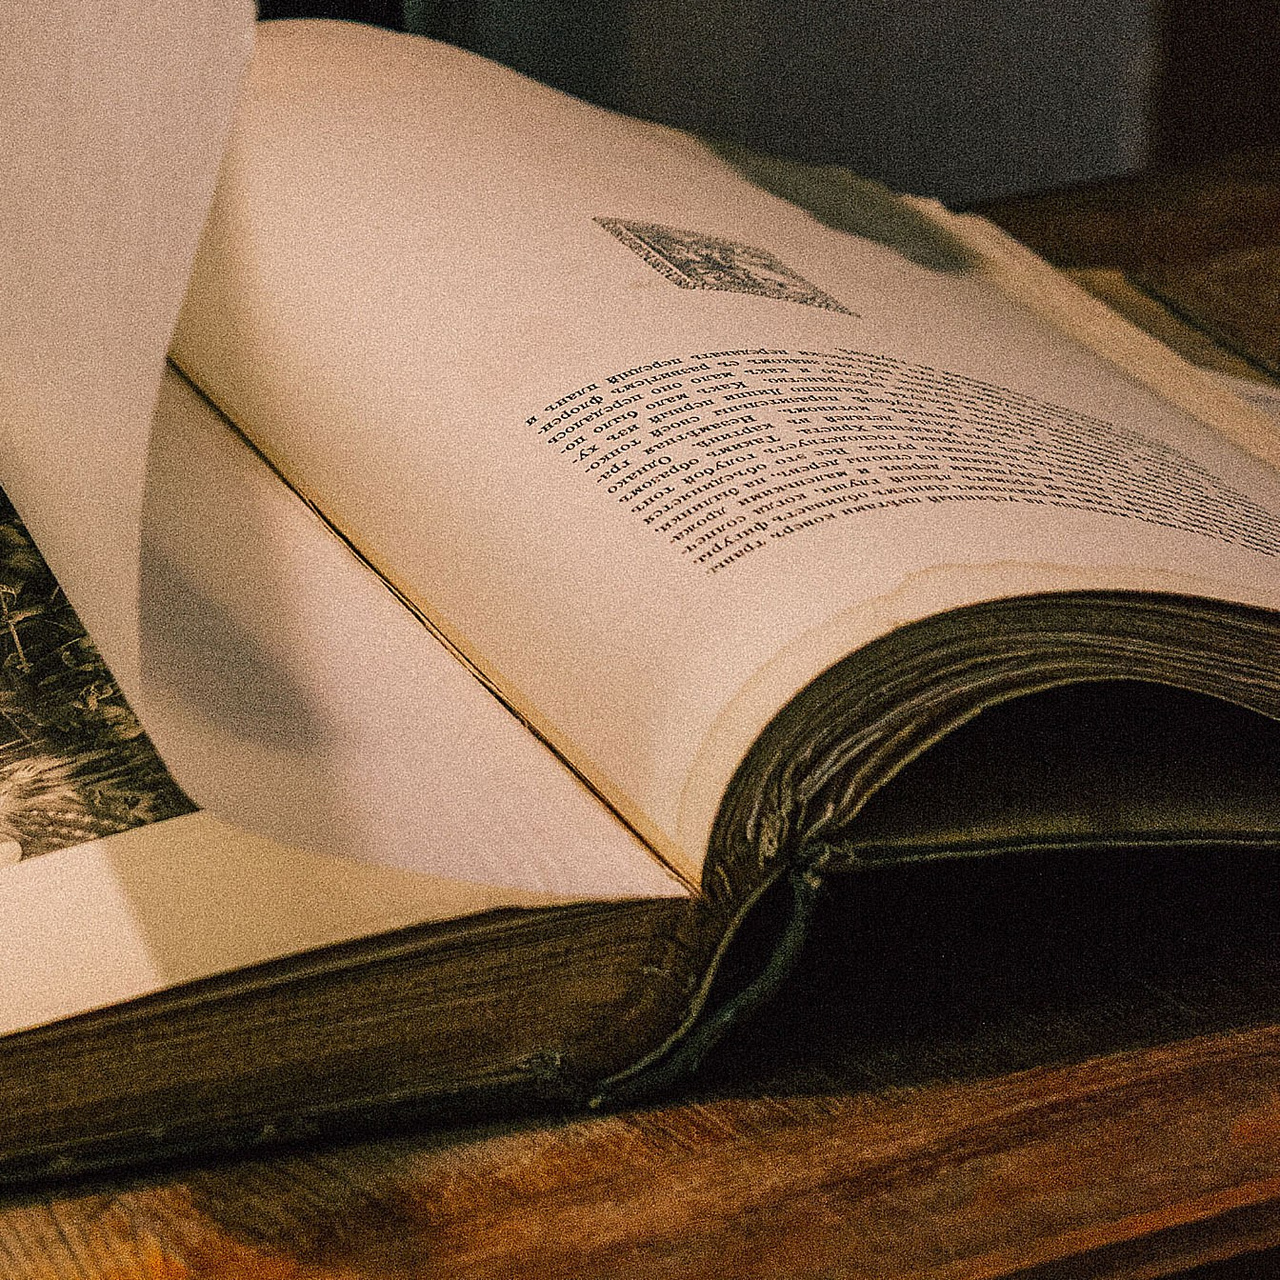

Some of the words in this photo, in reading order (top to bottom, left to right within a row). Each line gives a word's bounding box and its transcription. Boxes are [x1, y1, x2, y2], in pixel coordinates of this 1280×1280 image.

[690, 346, 789, 361] передавать
[606, 358, 683, 384] передній
[610, 362, 710, 394] развитіемъ
[690, 371, 735, 385] мало
[743, 368, 790, 376] какъ
[544, 383, 600, 412] планъ
[651, 382, 682, 396] оно
[697, 381, 748, 394] Какъ
[723, 388, 783, 401] Липпи
[645, 393, 689, 411] мало
[647, 399, 715, 425] первый
[713, 394, 840, 416] поразительны
[525, 414, 538, 427] и
[537, 395, 603, 436] флорен-
[547, 393, 643, 444] передалось
[592, 410, 638, 434] было
[648, 416, 700, 438] своей
[786, 417, 812, 425] въ
[606, 424, 640, 442] изъ
[643, 414, 757, 458] Незамѣтная
[691, 421, 775, 449] картинѣ.
[796, 423, 870, 435] Христа.
[560, 435, 587, 454] по-
[572, 443, 600, 464] ху-
[584, 438, 642, 474] тонко-
[705, 434, 781, 458] Такимъ
[813, 446, 850, 458] Все
[680, 452, 758, 485] голубой
[770, 459, 840, 478] деревъ,
[774, 453, 807, 465] это
[596, 459, 631, 484] гра-
[607, 455, 672, 494] Однако
[619, 458, 699, 503] образомъ
[742, 477, 767, 489] на
[642, 462, 767, 526] объединяется
[738, 470, 848, 506] маленькими
[814, 479, 880, 494] глуши,
[631, 486, 675, 513] тонъ
[654, 487, 739, 534] былинки,
[752, 493, 807, 516] когда
[772, 492, 868, 522] обливаетъ
[841, 496, 922, 515] цвѣтами
[669, 506, 728, 544] дрожа-
[681, 515, 747, 555] солнеч-
[770, 512, 837, 538] коверъ
[692, 521, 768, 564] фигуры.
